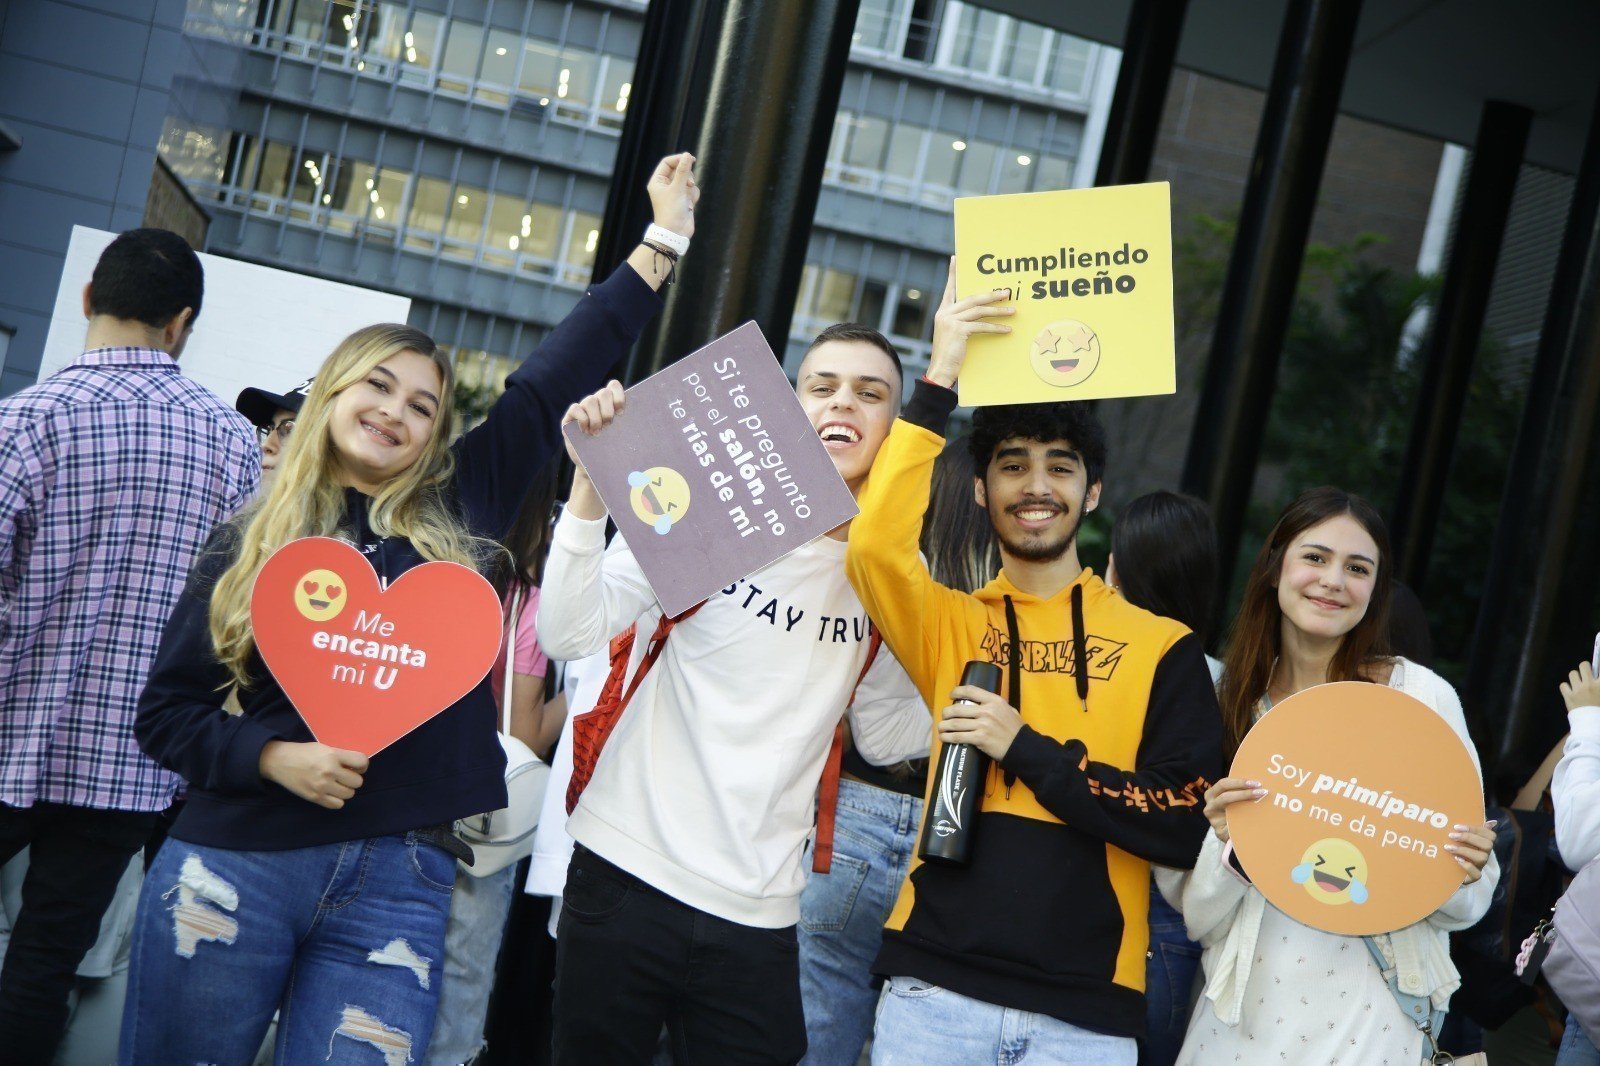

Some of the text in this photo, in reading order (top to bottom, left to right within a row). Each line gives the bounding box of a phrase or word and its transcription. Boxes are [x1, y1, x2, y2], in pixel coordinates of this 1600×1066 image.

[976, 243, 1149, 277] Cumpliendo
[1031, 271, 1136, 300] sueño
[682, 372, 786, 537] por el salón, no
[713, 357, 811, 519] Si te pregunto
[668, 398, 761, 538] te rías de mí
[353, 609, 396, 637] Me
[312, 631, 427, 668] encanta
[331, 662, 399, 690] mi U
[1267, 754, 1449, 829] Soy primíparo
[1273, 792, 1303, 813] no
[1308, 804, 1343, 826] me
[1349, 814, 1377, 838] da
[1381, 828, 1438, 859] pena
